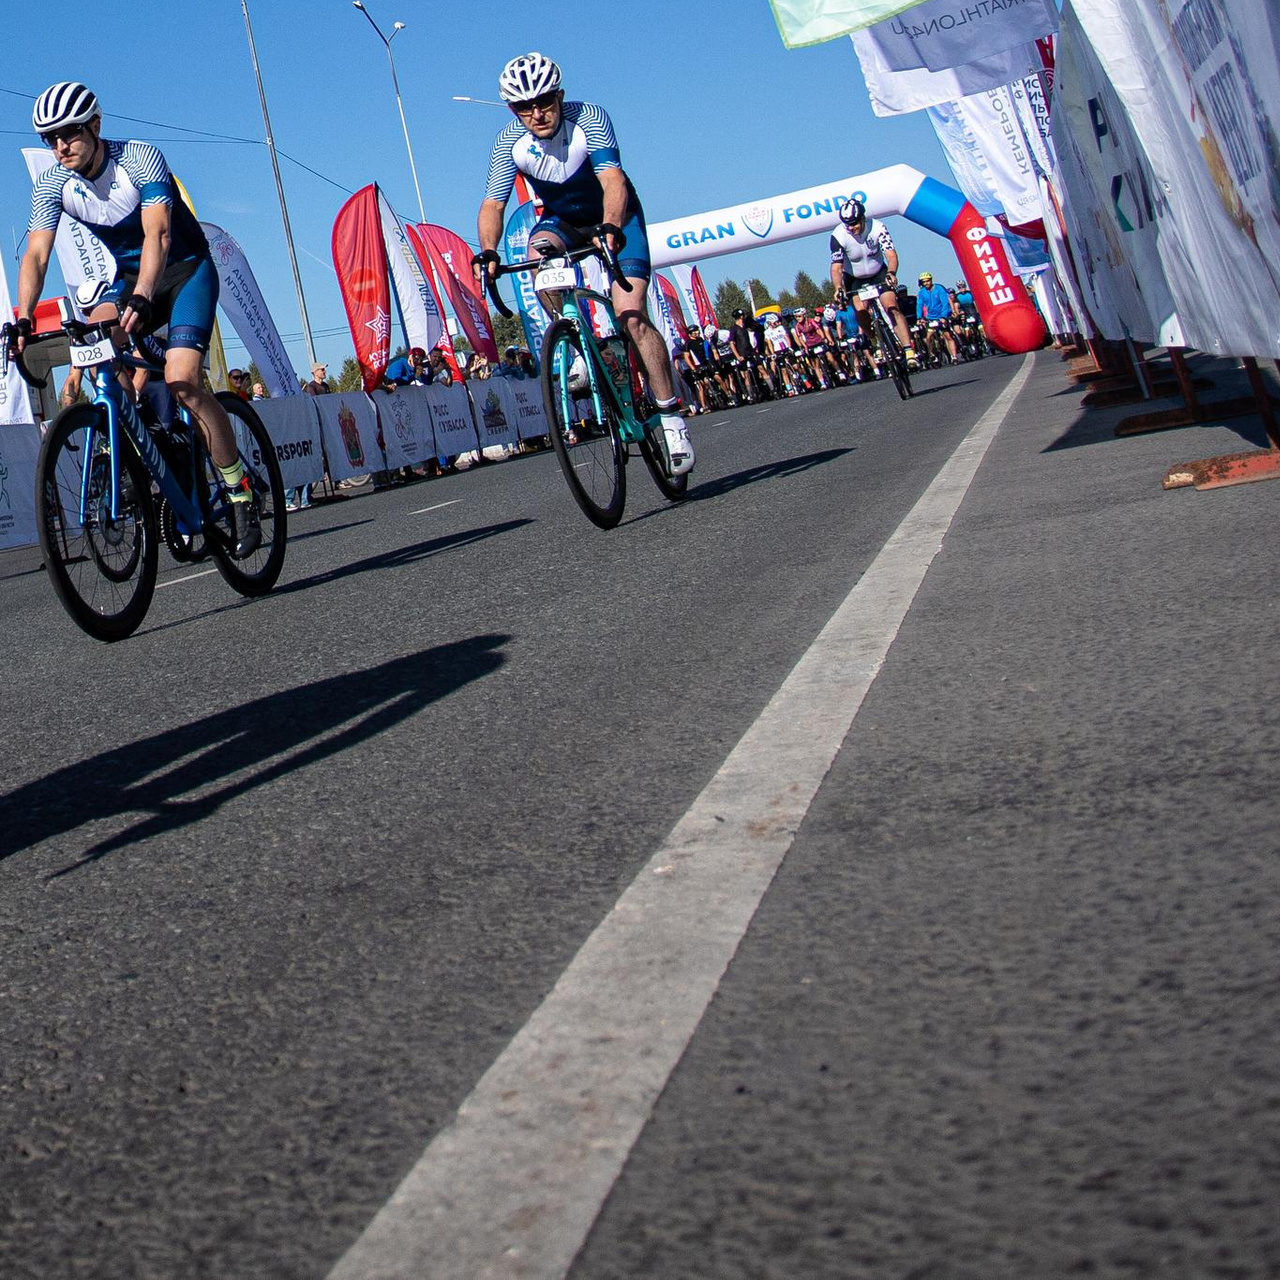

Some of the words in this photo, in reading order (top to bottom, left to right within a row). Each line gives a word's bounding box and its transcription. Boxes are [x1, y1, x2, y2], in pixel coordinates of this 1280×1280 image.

[666, 221, 736, 249] GRAN
[783, 190, 868, 223] FONDO
[541, 271, 566, 285] 035
[966, 226, 1015, 306] ФИНИШ
[76, 347, 103, 363] 028
